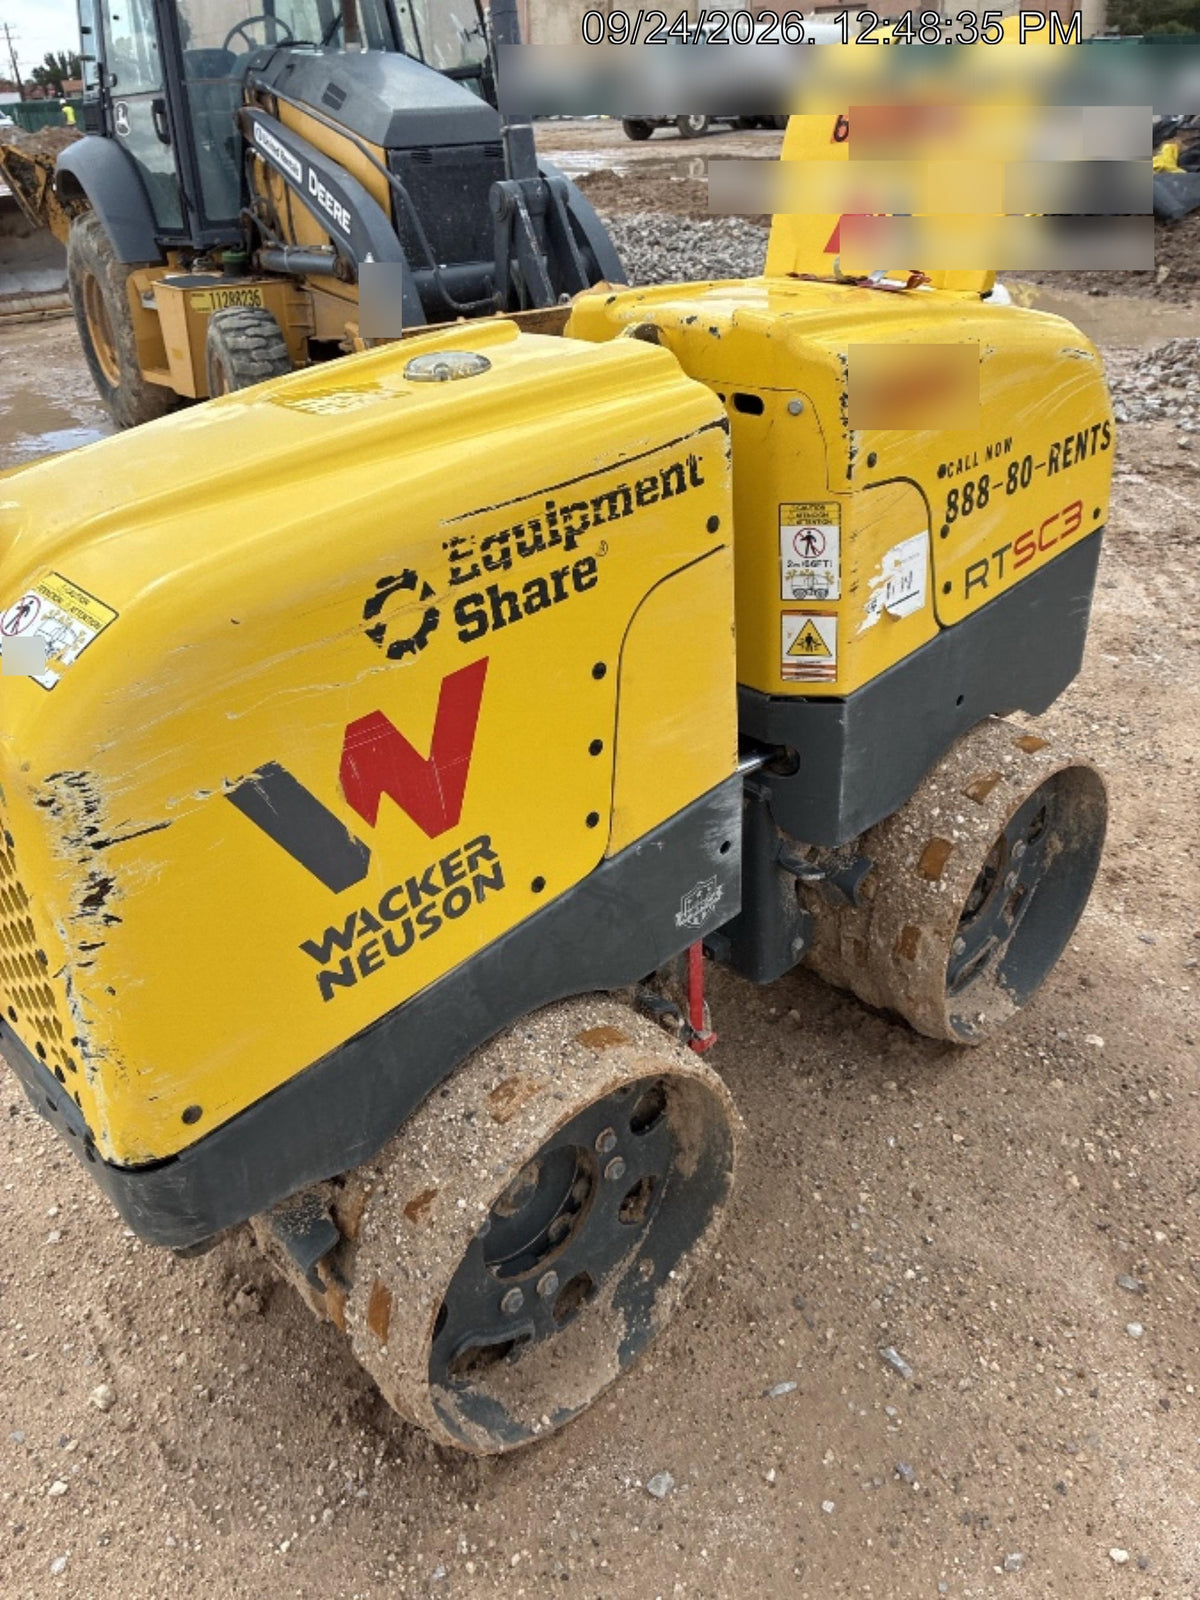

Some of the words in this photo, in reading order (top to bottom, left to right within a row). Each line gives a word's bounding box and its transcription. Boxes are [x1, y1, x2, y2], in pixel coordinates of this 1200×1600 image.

[308, 166, 351, 235] DEERE
[945, 419, 1112, 524] 888-80-RENTS
[946, 451, 979, 478] CALL
[985, 436, 1013, 463] NOW
[442, 452, 705, 587] Equipment
[965, 499, 1083, 600] RTSC3
[298, 835, 499, 966] WACKER
[316, 861, 506, 1003] NEUSON
